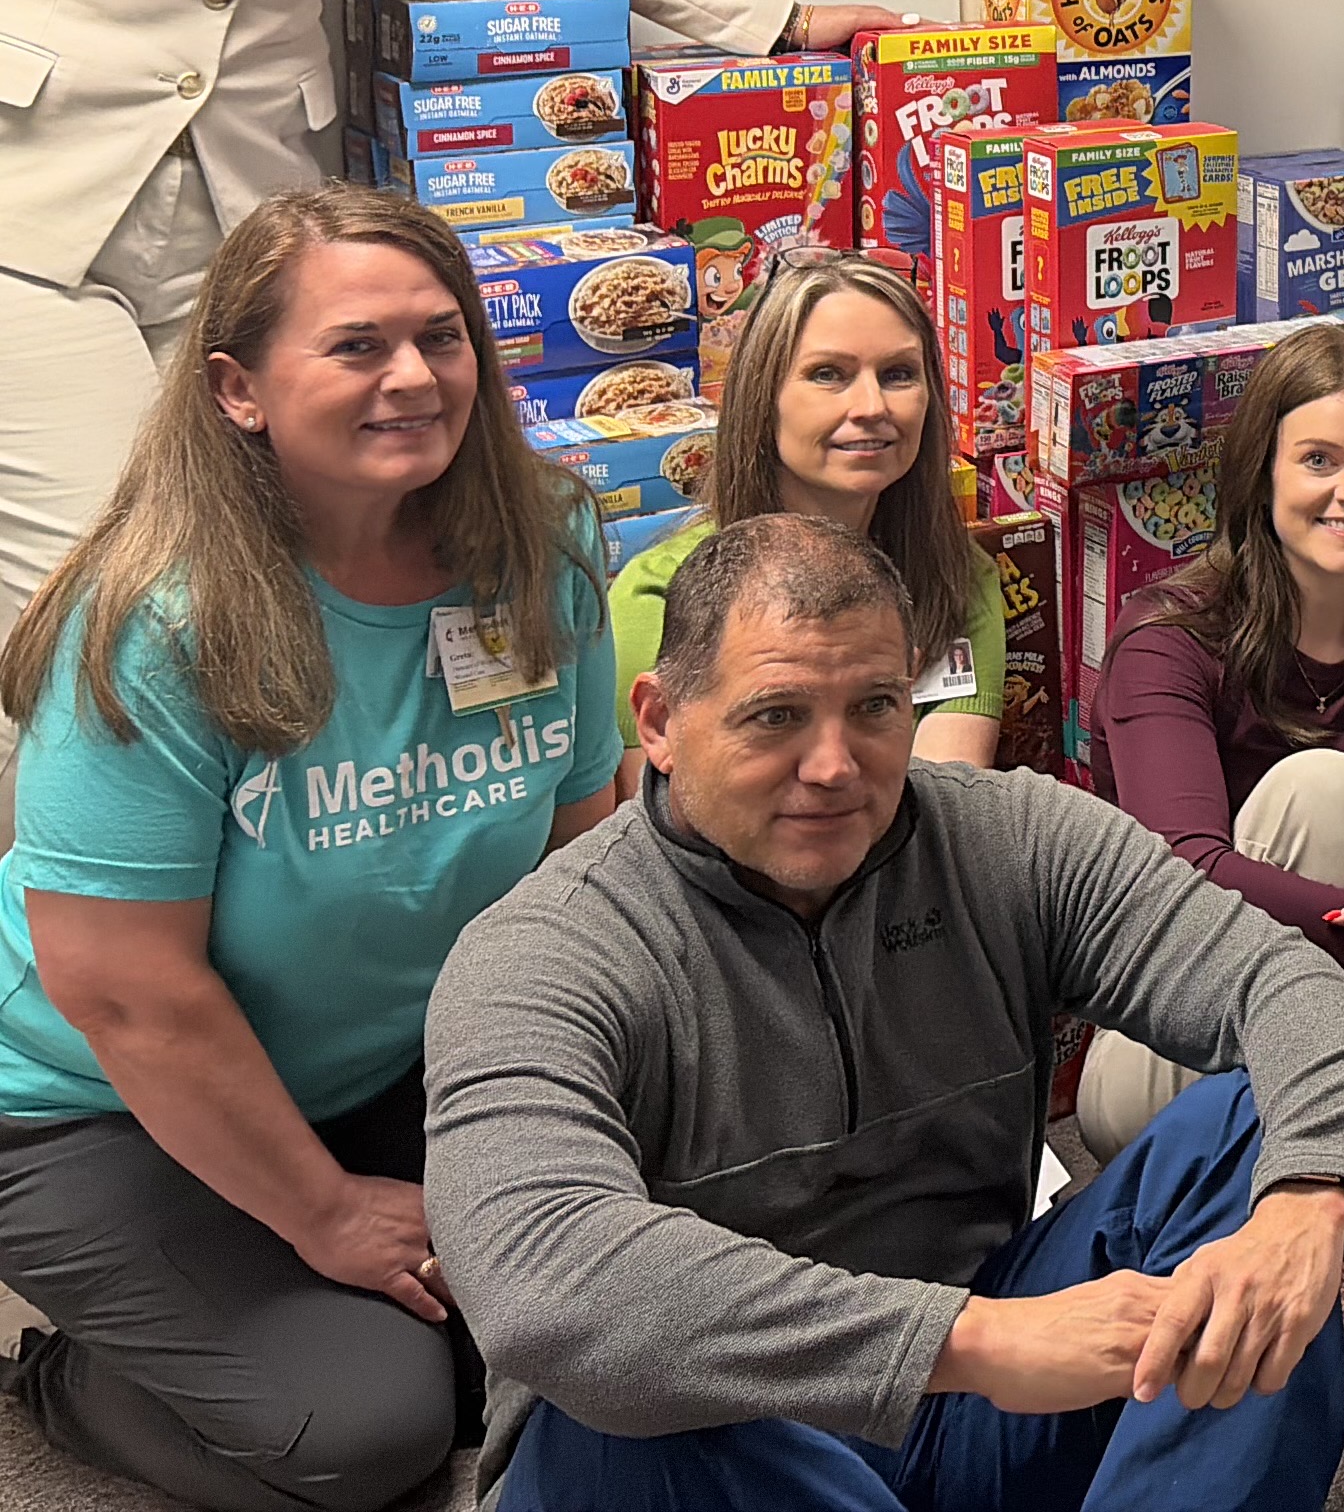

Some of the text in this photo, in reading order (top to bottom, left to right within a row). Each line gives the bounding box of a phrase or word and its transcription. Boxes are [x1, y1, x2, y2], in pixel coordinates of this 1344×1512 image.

[487, 17, 561, 34] SUGAR FREE
[419, 34, 441, 44] 22g
[494, 32, 556, 42] INSTANT OATMEAL
[909, 34, 1032, 55] FAMILY SIZE
[428, 56, 448, 64] LOW
[492, 52, 555, 66] CINNAMON SPICE
[907, 55, 1020, 70] 9 FIBER 15g
[722, 66, 832, 90] FAMILY SIZE
[414, 96, 482, 114] SUGAR FREE
[896, 78, 1008, 140] FROOT
[420, 110, 478, 120] INSTANT OATMEAL
[434, 129, 497, 144] CINNAMON SPICE
[717, 125, 796, 165] Lucky
[1072, 148, 1141, 162] FAMILY SIZE
[428, 173, 495, 190] SUGAR FREE
[706, 158, 804, 196] Charms
[1065, 167, 1138, 200] FREE
[1203, 174, 1234, 182] CARDS!
[434, 186, 492, 198] INSTANT OATMEAL
[446, 202, 506, 218] FRENCH VANILLA
[1069, 189, 1141, 218] INSIDE
[754, 214, 802, 238] LIMITED
[1104, 226, 1162, 244] Kellogg's
[1096, 242, 1170, 273] FROOT
[1186, 249, 1214, 258] NATURAL
[1096, 268, 1171, 300] LOOPS
[513, 293, 542, 318] PACK
[502, 318, 536, 328] OATMEAL
[1080, 374, 1122, 401] FROOT
[1147, 372, 1198, 393] FROSTED
[1150, 382, 1192, 402] FLAKES
[520, 400, 548, 422] PACK
[308, 776, 526, 852] HEALTHCARE
